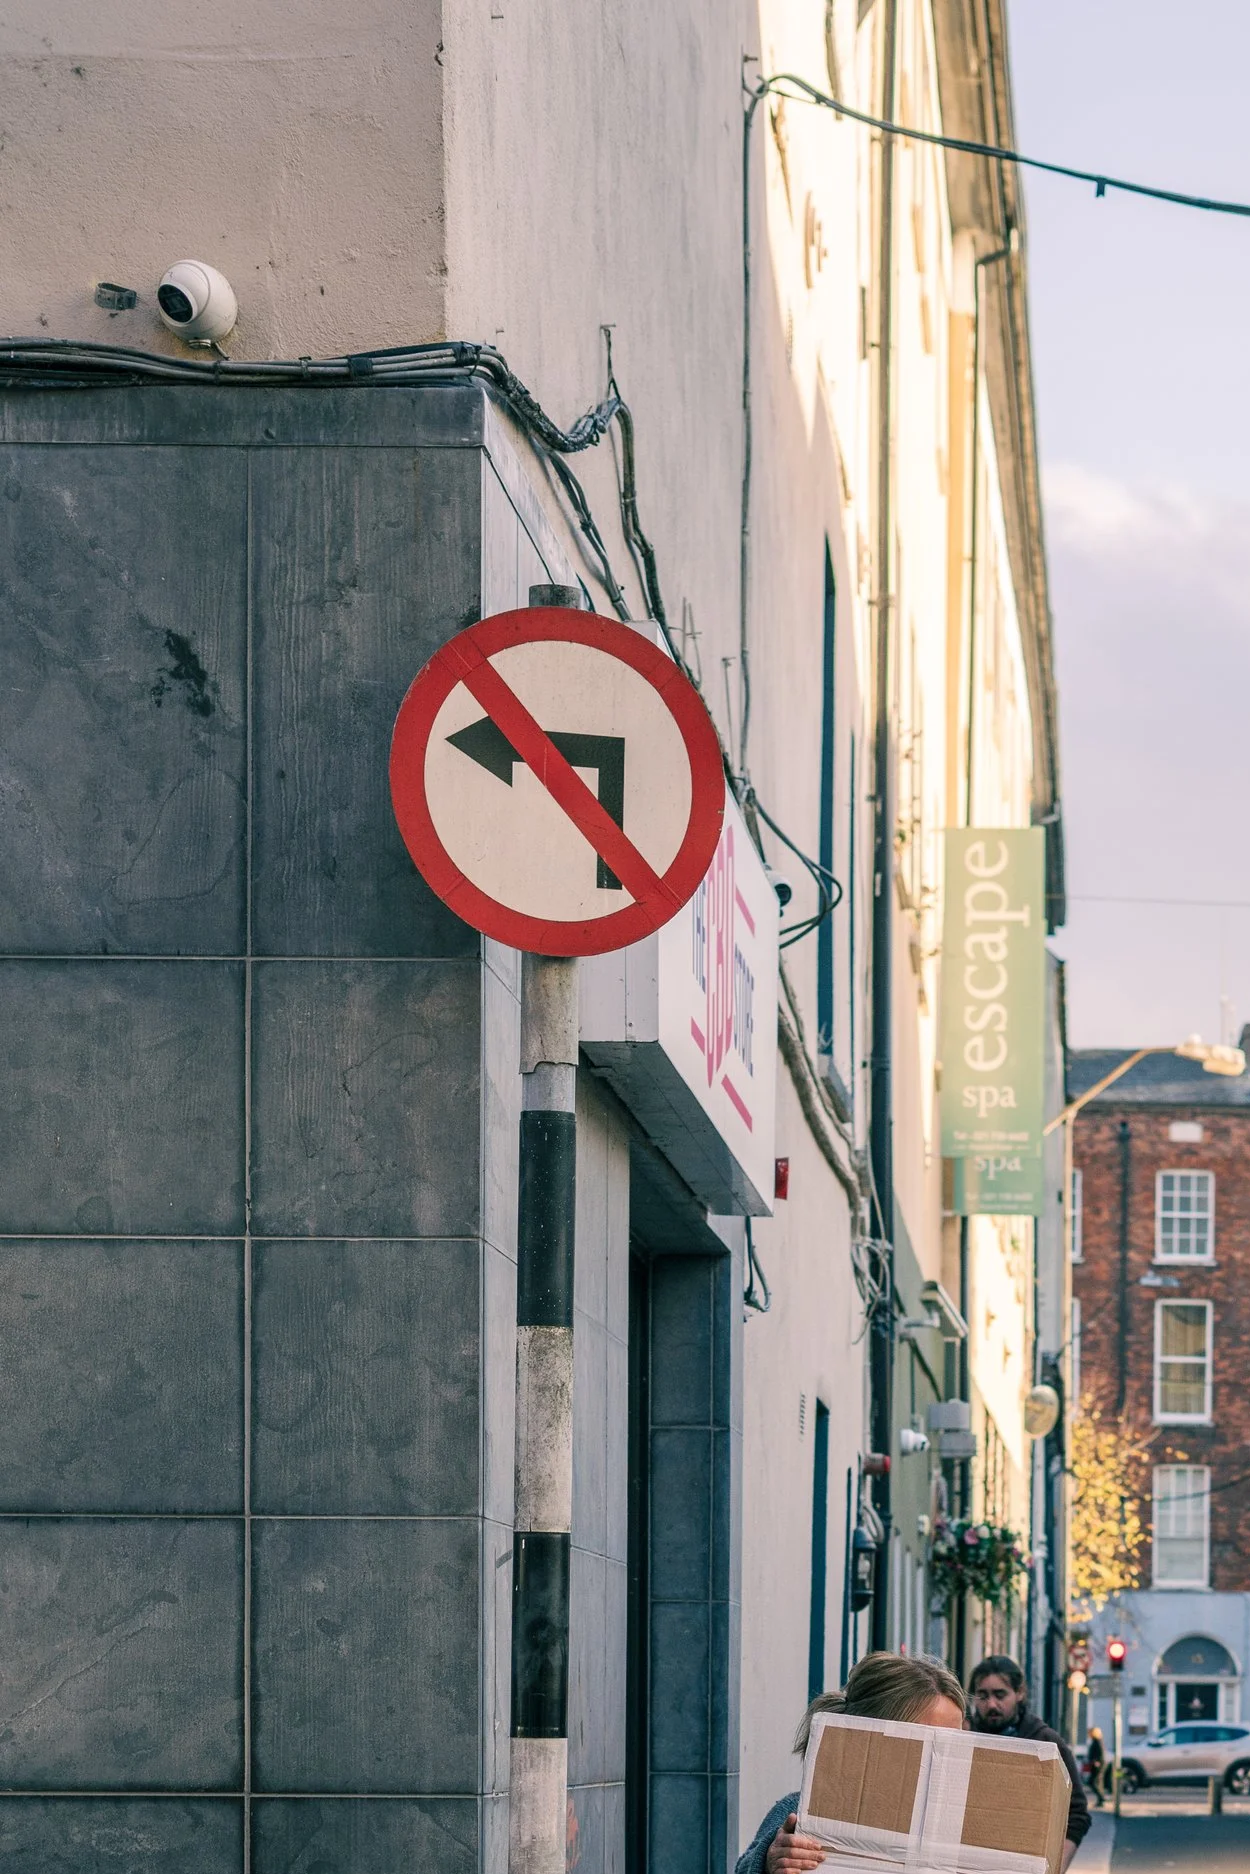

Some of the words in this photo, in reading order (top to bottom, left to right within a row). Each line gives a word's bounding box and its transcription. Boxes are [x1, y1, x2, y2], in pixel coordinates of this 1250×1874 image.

[706, 824, 735, 1088] CBD
[734, 940, 754, 1079] STORE
[963, 840, 1030, 1072] escape
[962, 1083, 1018, 1118] spa
[974, 1155, 1023, 1181] spa
